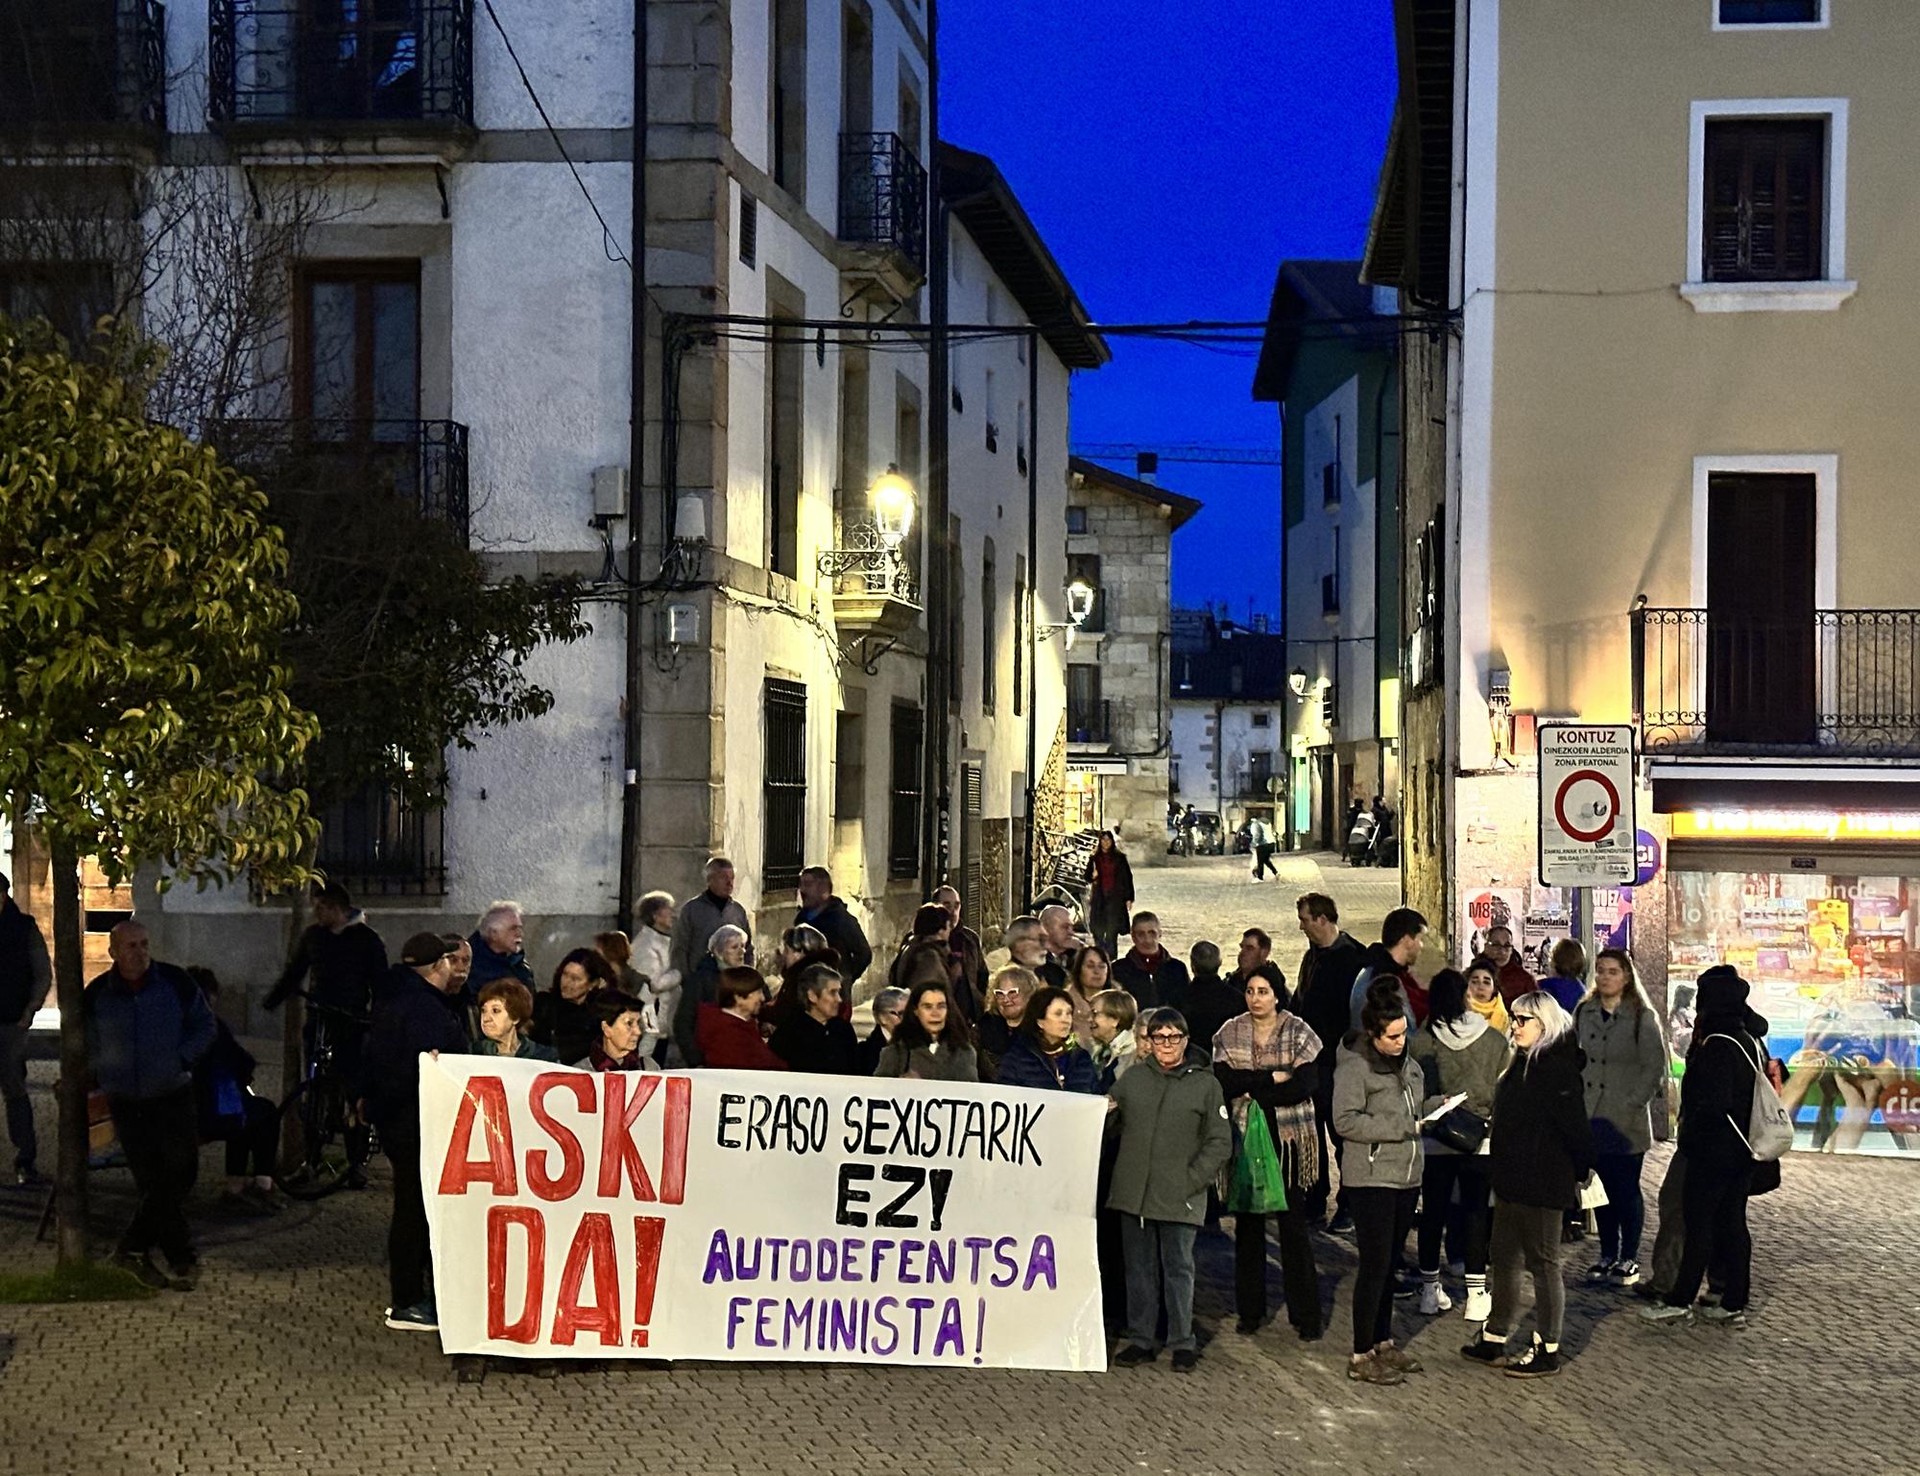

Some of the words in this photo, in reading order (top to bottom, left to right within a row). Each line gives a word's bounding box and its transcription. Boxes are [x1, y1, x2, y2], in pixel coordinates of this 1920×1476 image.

[1557, 731, 1616, 743] KONTUZ
[1469, 902, 1490, 918] M8
[1683, 904, 1701, 922] lo
[437, 1072, 692, 1205] ASKI
[717, 1094, 829, 1154] ERASO
[843, 1095, 1045, 1166] SEXISTARIK
[836, 1166, 953, 1231] EZ!
[487, 1205, 666, 1348] DA!
[702, 1229, 1058, 1291] AUTODEFENTSA
[727, 1296, 987, 1366] FEMINISTA!
